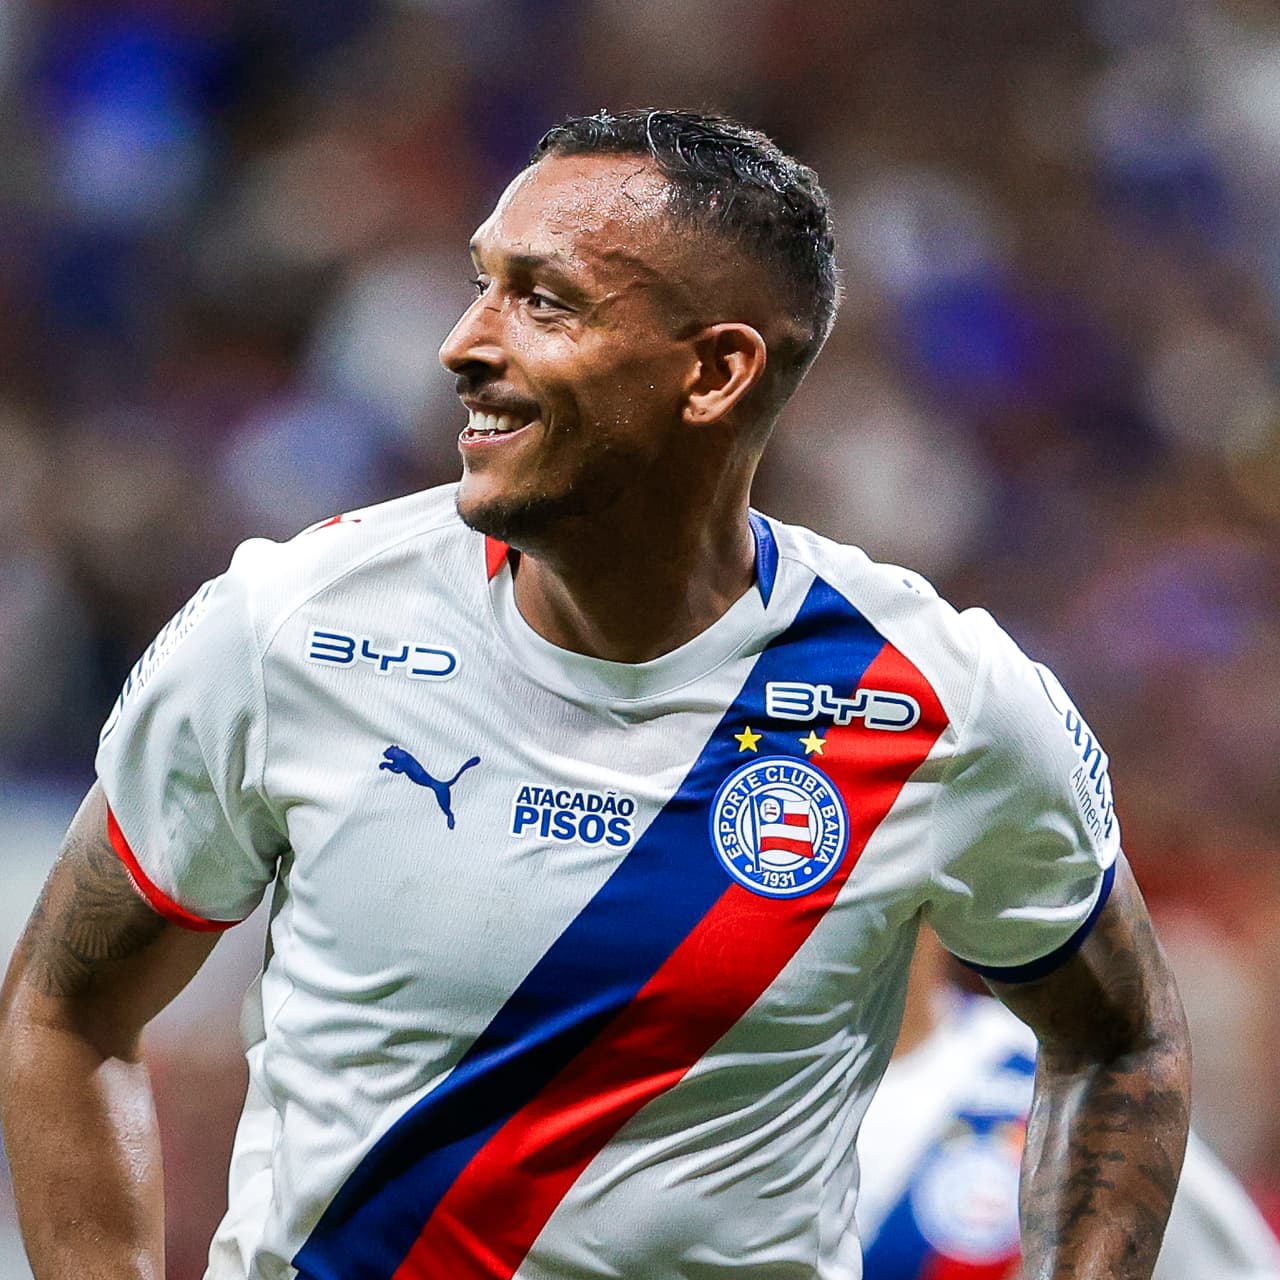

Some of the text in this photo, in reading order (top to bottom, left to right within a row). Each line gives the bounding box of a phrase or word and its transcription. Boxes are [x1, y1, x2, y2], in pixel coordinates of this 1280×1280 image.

[309, 631, 457, 677] BYD
[771, 686, 916, 727] BYD
[516, 786, 635, 817] ATACADÃO
[721, 767, 839, 864] ESPORTE CLUBE BAHIA
[512, 805, 632, 847] PISOS
[761, 871, 796, 887] 1931
